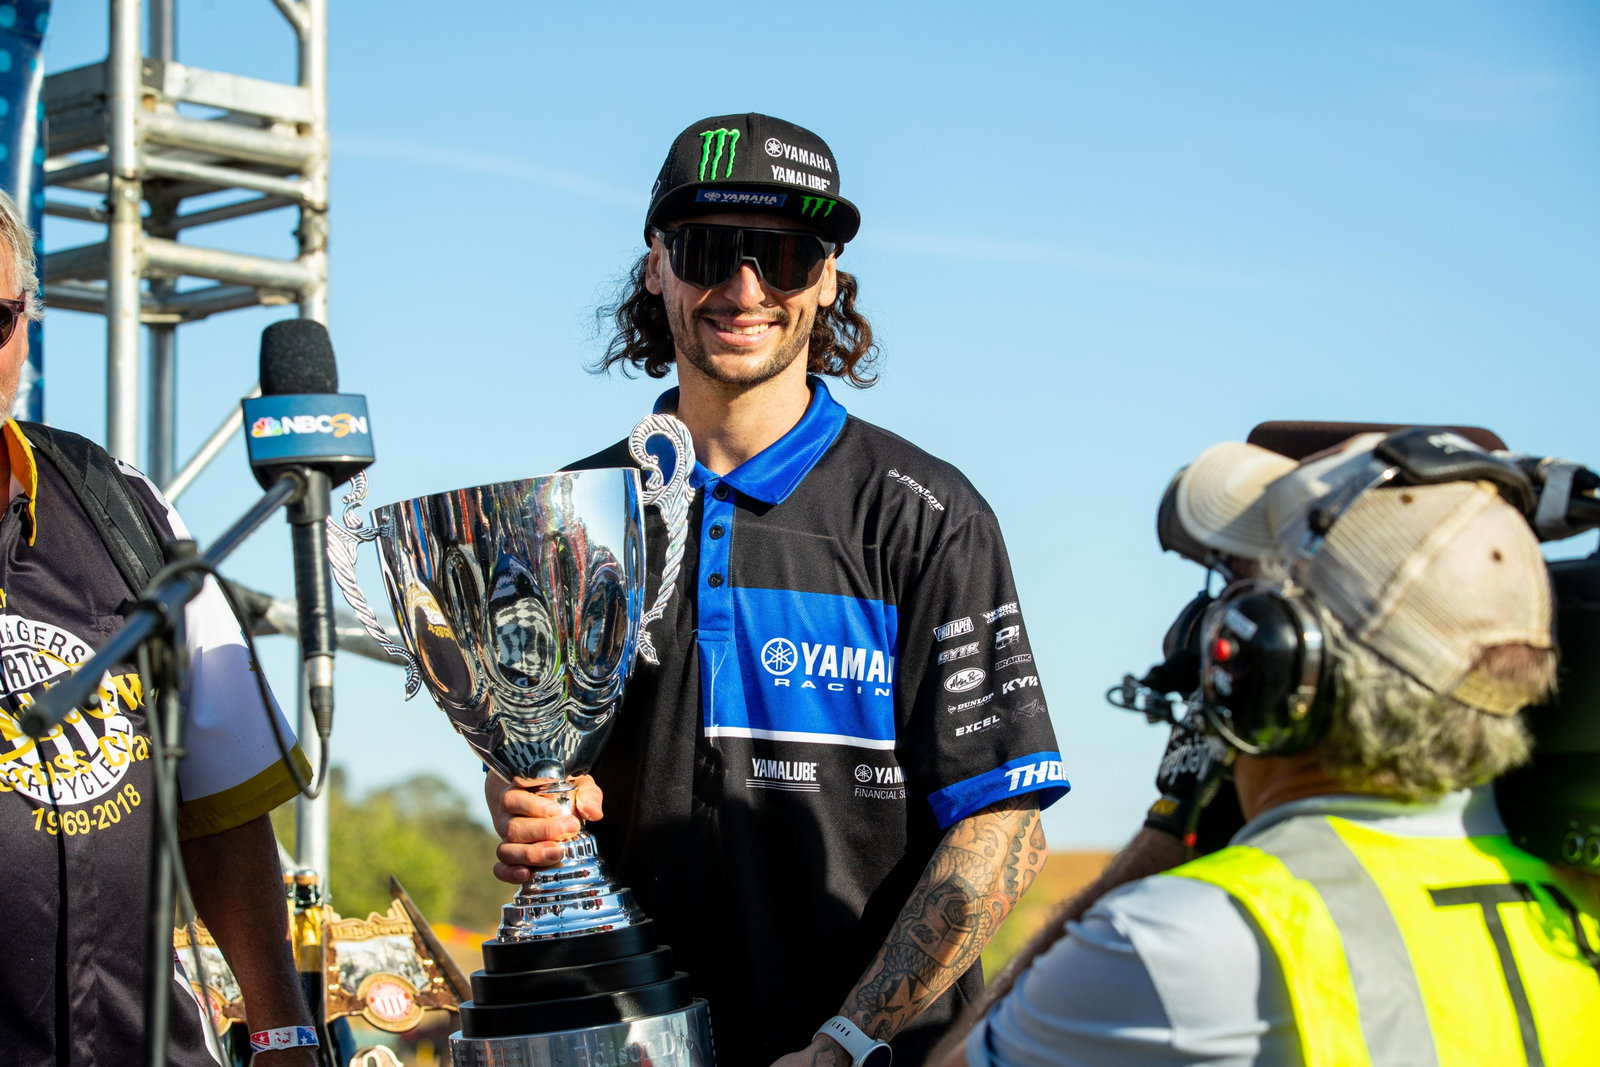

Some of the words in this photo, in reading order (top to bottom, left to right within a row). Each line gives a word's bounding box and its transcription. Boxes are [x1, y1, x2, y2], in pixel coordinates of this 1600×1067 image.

[782, 143, 832, 173] YAMAHA
[771, 165, 829, 191] YAMALUBE
[723, 193, 777, 203] YAMAHA
[281, 413, 368, 438] NBCSN
[899, 475, 944, 511] DUNLOP
[2, 651, 52, 688] RTH
[957, 692, 994, 710] DUNLOP
[955, 715, 1000, 737] EXCEL
[752, 758, 818, 781] YAMALUBE
[1004, 760, 1066, 792] THO
[855, 787, 897, 800] FINANCIAL
[31, 783, 141, 836] 1969-2018
